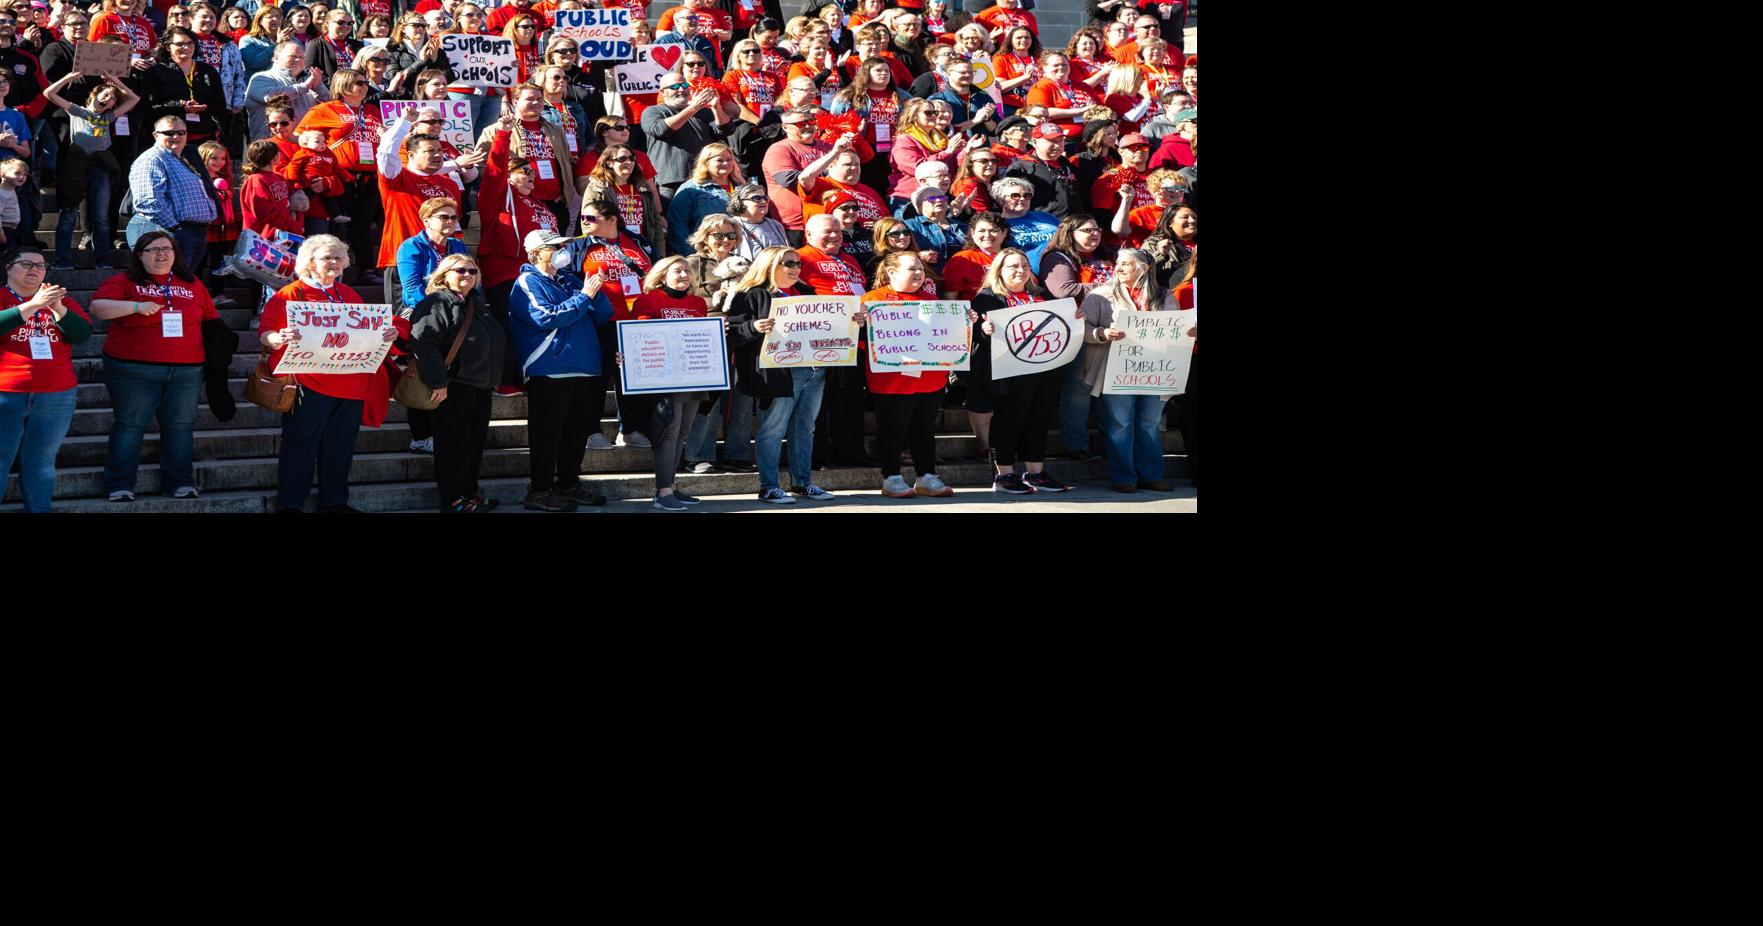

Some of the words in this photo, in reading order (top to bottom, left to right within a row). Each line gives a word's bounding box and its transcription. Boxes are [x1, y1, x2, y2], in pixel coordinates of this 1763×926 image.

[556, 10, 629, 27] PUBLIC
[442, 35, 512, 56] SUPPORT
[580, 40, 632, 58] OUD
[618, 72, 653, 92] PUBLIC
[776, 305, 789, 316] NO
[795, 303, 847, 316] VOUCHER
[871, 308, 912, 321] PUBLIC
[297, 311, 340, 327] JUST
[346, 311, 383, 330] SAY
[784, 321, 831, 333] SCHEMES
[1128, 315, 1186, 328] PUBLIC
[19, 328, 56, 336] PUBLIC
[875, 329, 921, 339] BELONG
[1011, 320, 1033, 344] LB
[321, 332, 350, 348] NO
[1028, 331, 1061, 358] 753
[878, 344, 919, 354] PUBLIC
[927, 342, 968, 351] SCHOOLS
[1118, 344, 1143, 357] FOR
[1125, 359, 1176, 373] PUBLIC
[1113, 375, 1177, 386] SCHOOLS
